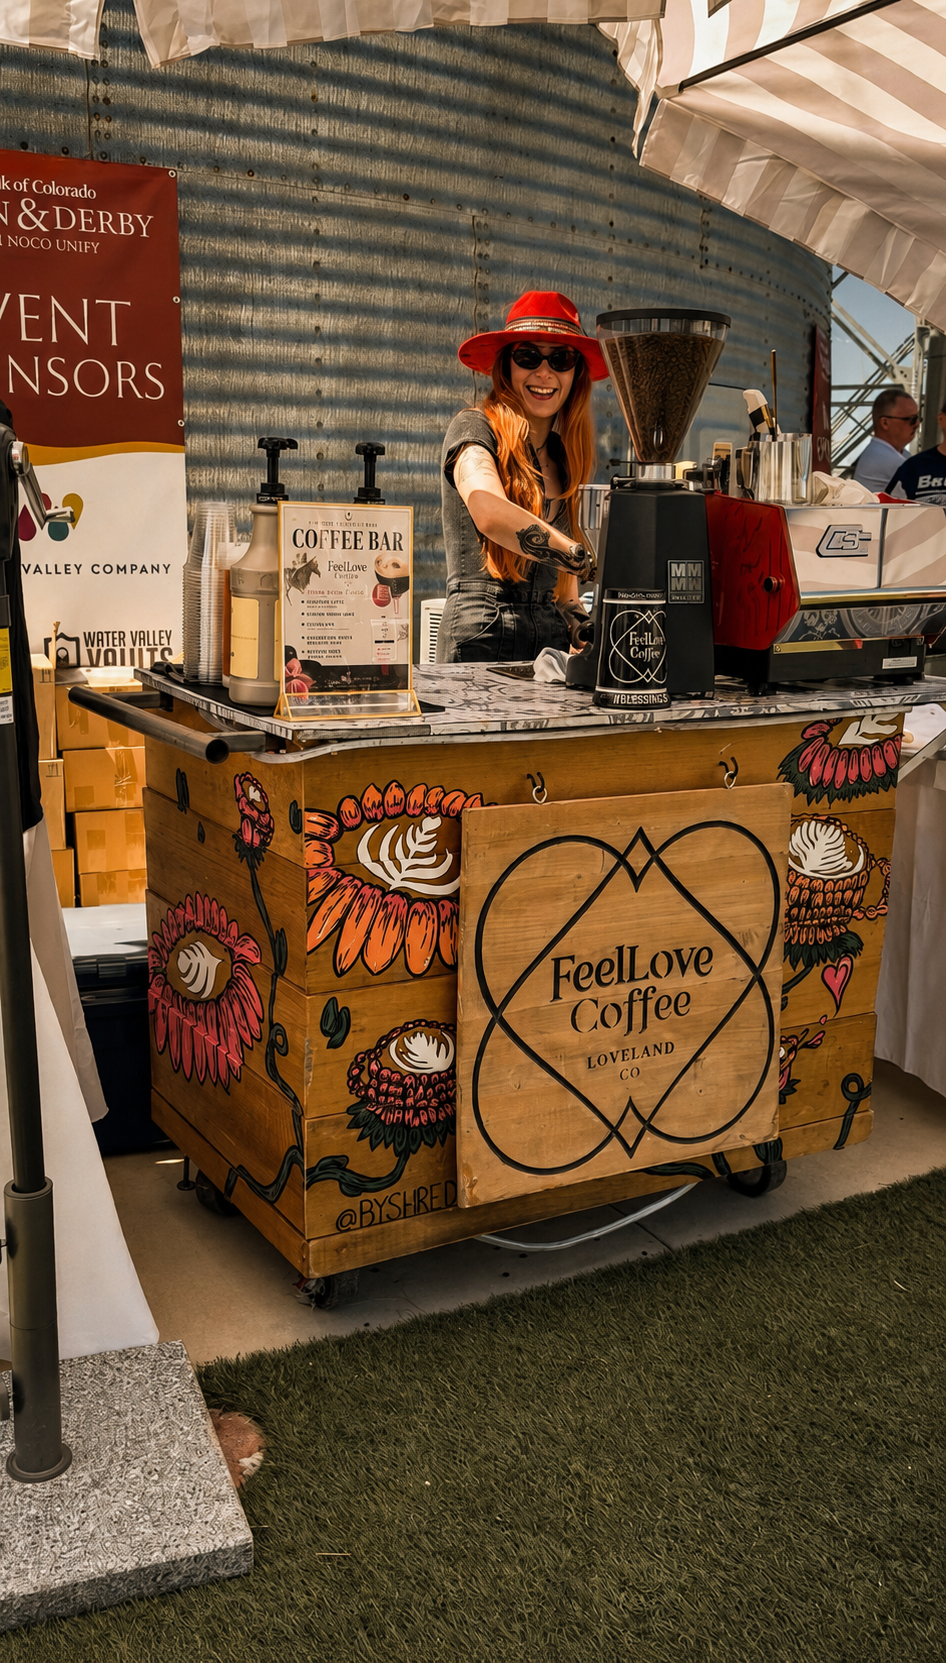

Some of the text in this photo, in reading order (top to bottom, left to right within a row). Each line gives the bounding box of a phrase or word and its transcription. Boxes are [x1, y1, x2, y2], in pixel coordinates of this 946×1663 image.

[13, 177, 30, 192] of
[32, 179, 97, 200] Colorado
[17, 197, 50, 232] &
[52, 205, 154, 238] DERBY
[7, 234, 52, 250] NOCO
[56, 239, 100, 254] UNIFY
[8, 354, 165, 401] NSORS
[292, 528, 404, 552] COFFEE BAR
[22, 563, 172, 575] VALLEY COMPANY
[328, 560, 368, 572] FeelLove
[83, 630, 172, 647] WATER VALLEY
[550, 944, 714, 1003] FeelLove
[571, 985, 691, 1037] Coffee
[587, 1041, 675, 1069] LOVELAND
[619, 1066, 641, 1081] CO
[335, 1180, 457, 1232] @BYSHRED
